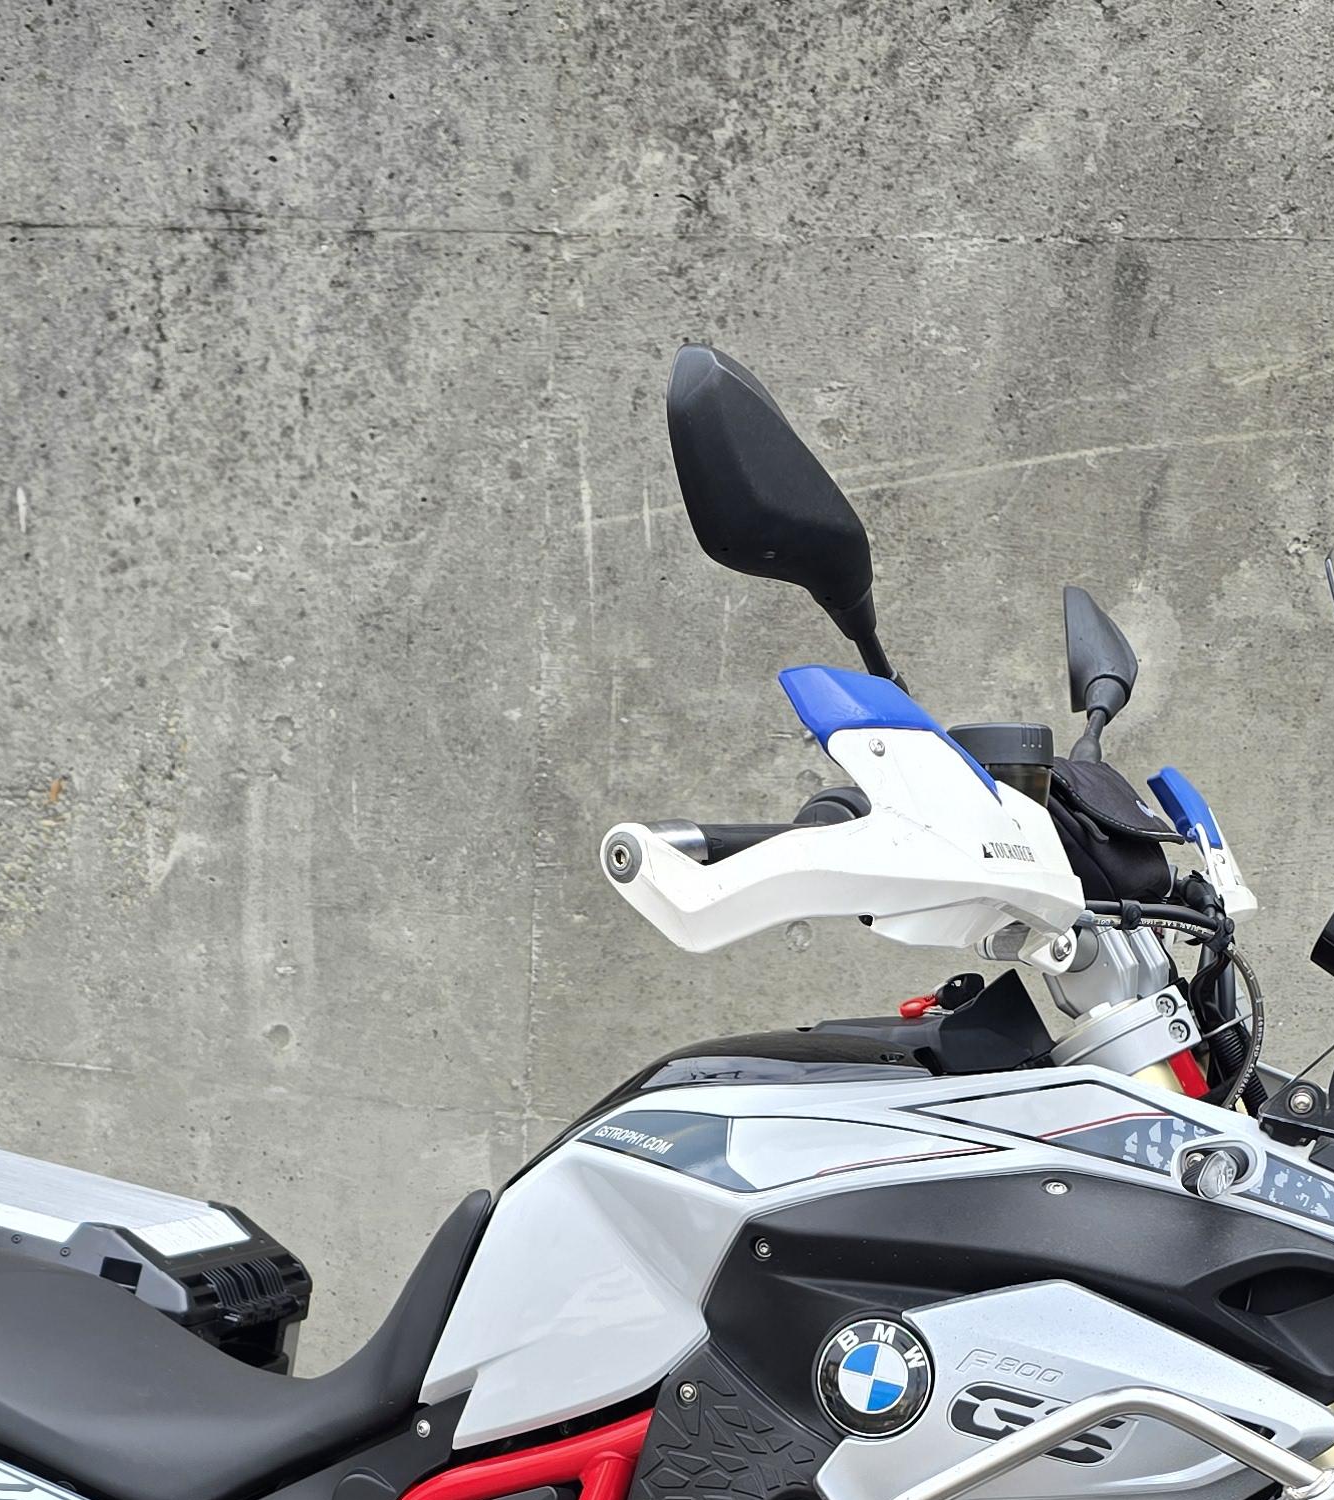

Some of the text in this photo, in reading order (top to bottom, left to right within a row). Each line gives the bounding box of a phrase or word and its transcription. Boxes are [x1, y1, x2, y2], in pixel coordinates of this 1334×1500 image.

[594, 1125, 675, 1155] GSTROPHY.COM
[837, 1322, 926, 1370] BMW
[955, 1348, 1066, 1385] F 800
